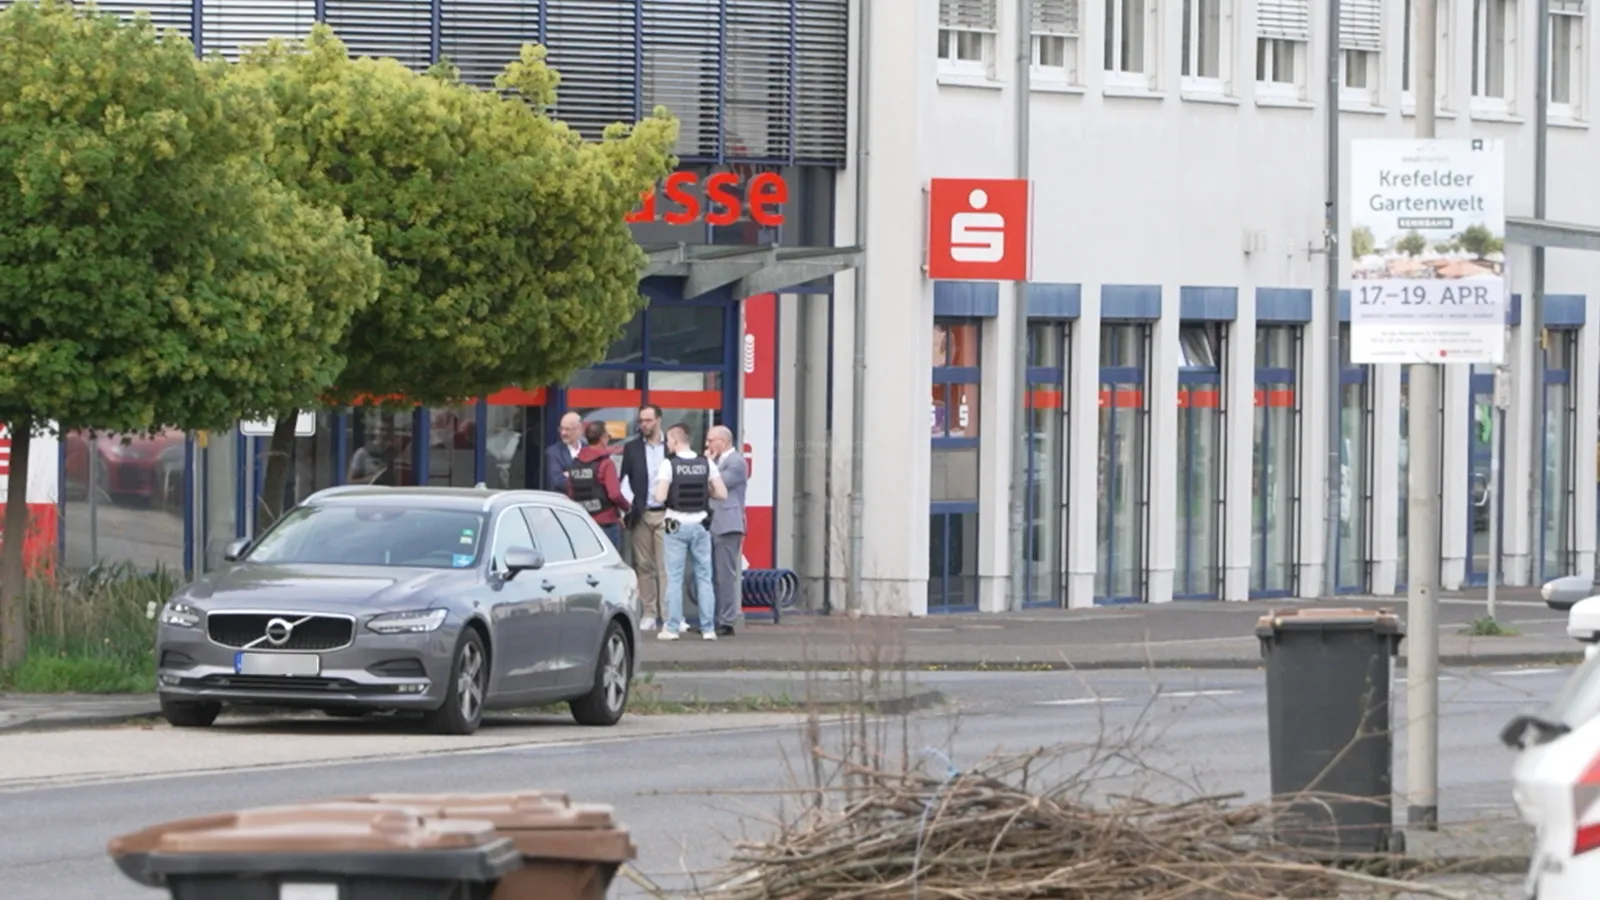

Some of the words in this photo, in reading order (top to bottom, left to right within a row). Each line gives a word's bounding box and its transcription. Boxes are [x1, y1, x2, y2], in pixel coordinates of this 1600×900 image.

[1379, 170, 1474, 187] Krefelder
[1369, 194, 1485, 212] Gartenwelt
[1439, 286, 1495, 306] APR.
[676, 465, 707, 475] POLIZEI
